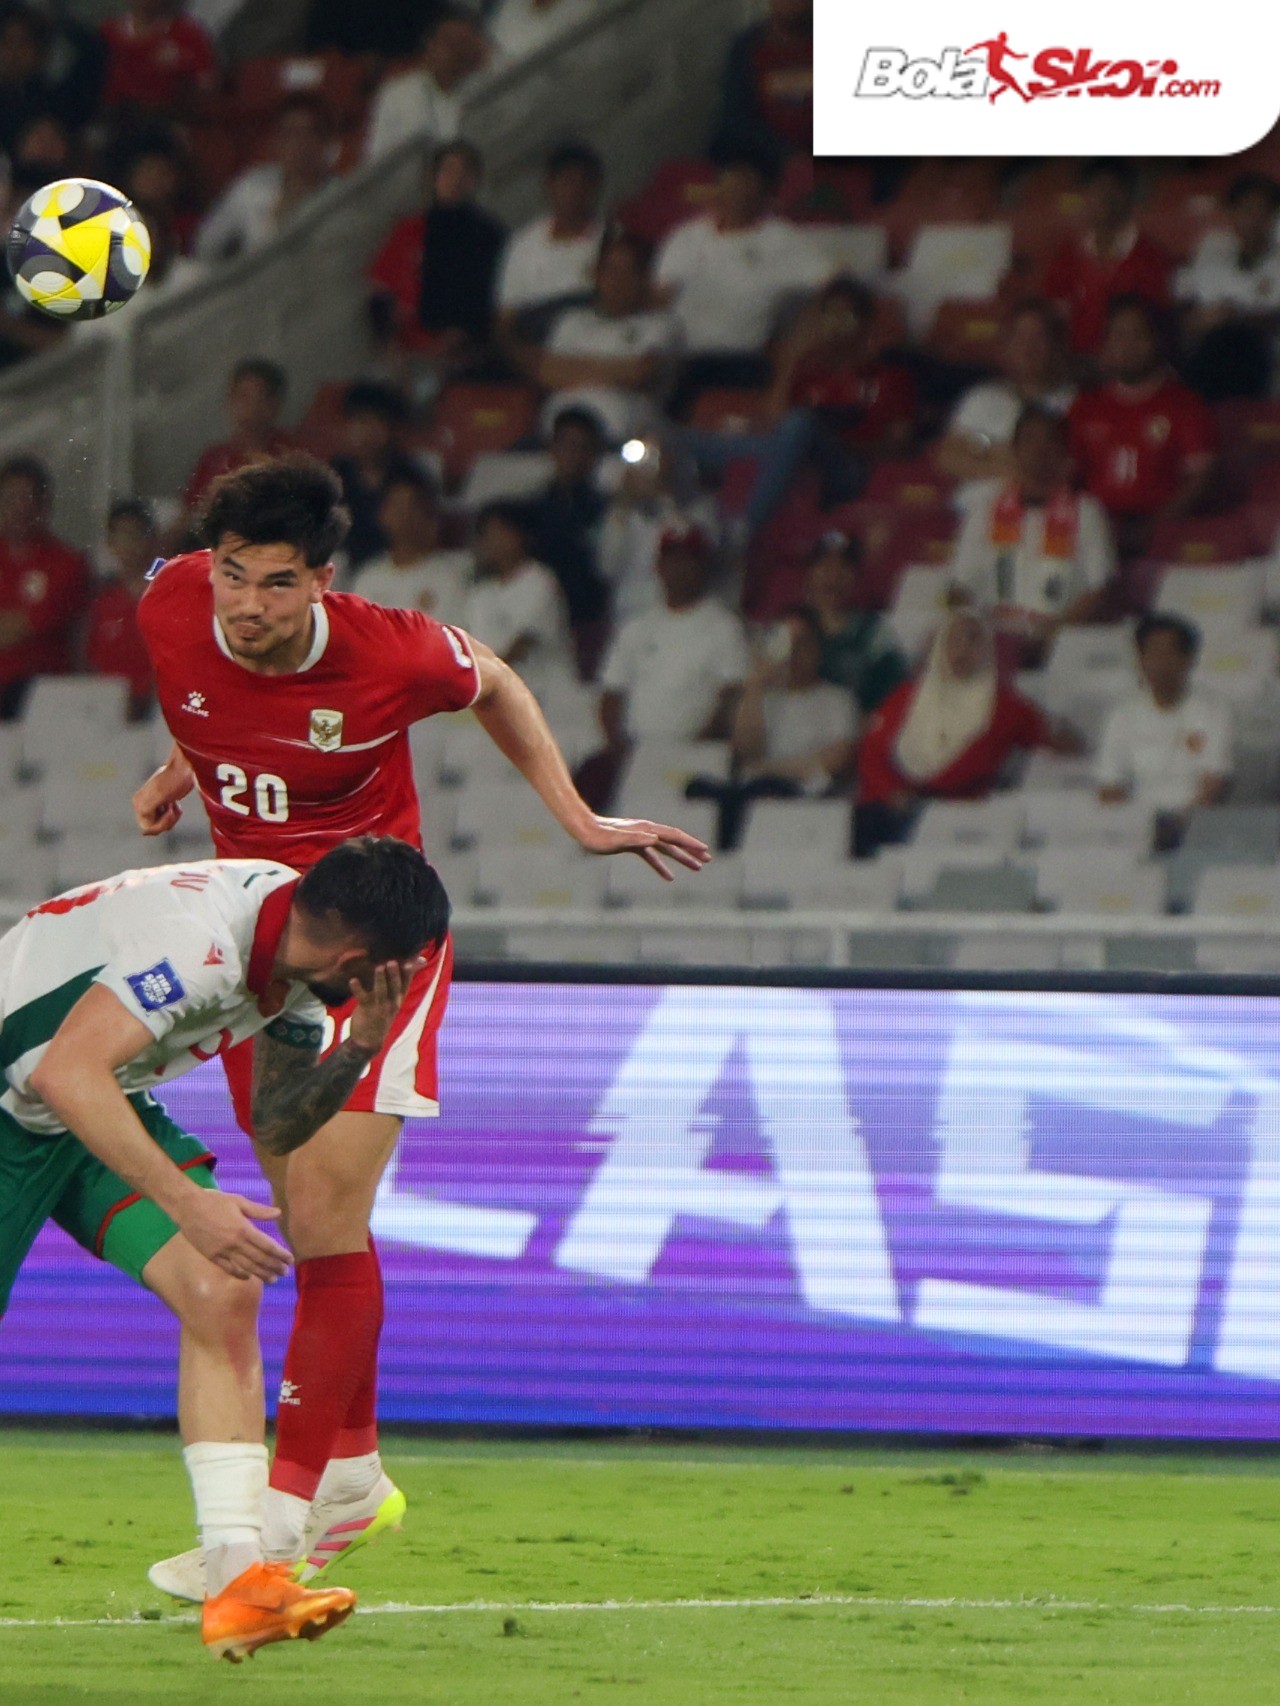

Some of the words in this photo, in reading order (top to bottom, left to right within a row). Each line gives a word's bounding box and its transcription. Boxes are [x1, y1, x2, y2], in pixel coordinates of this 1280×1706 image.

[181, 703, 210, 717] KELME
[216, 763, 289, 822] 20
[140, 979, 156, 1002] 2026
[144, 972, 166, 1003] SERIES
[155, 972, 172, 994] FIFA
